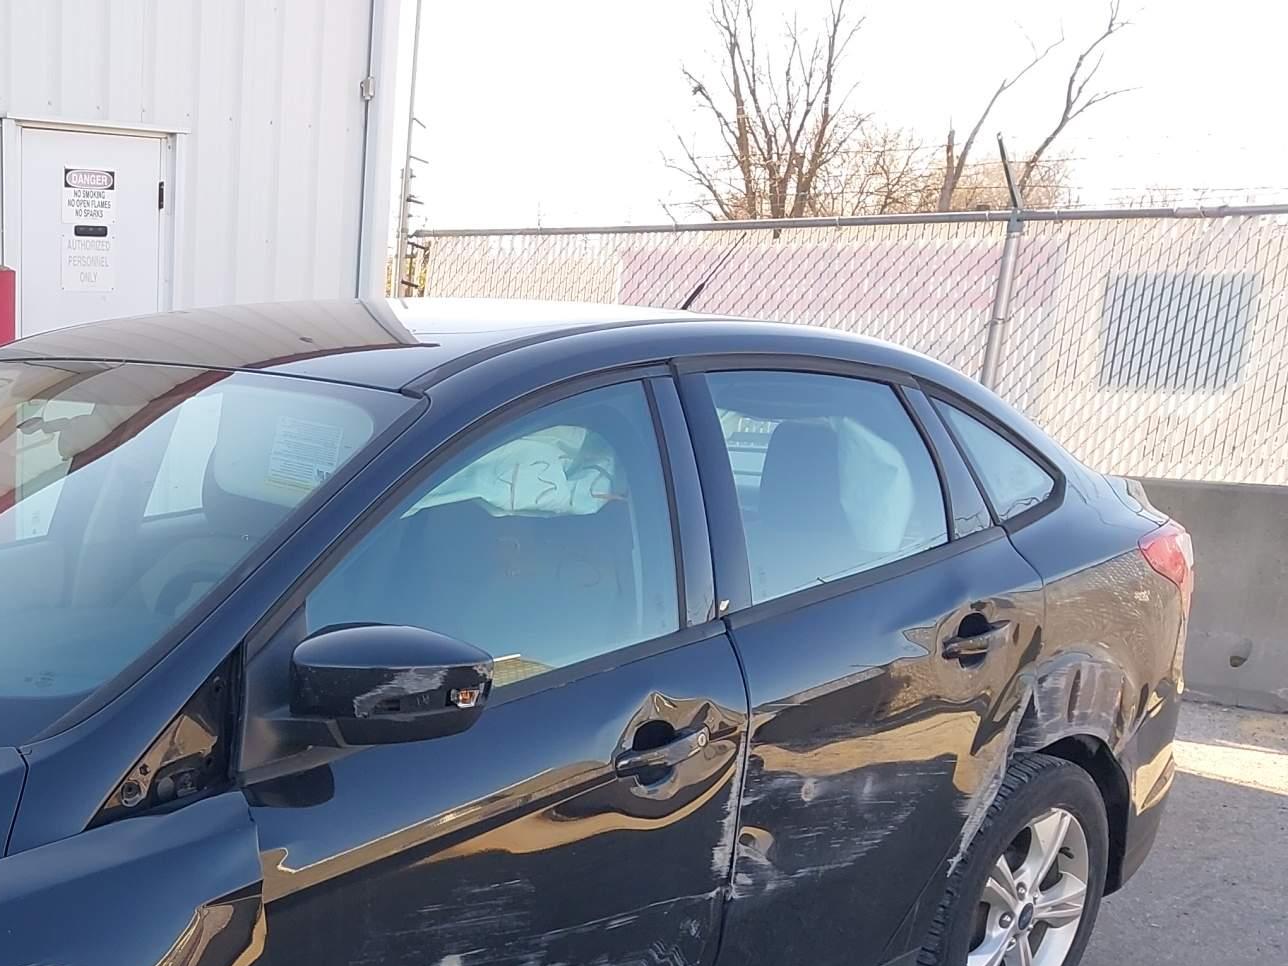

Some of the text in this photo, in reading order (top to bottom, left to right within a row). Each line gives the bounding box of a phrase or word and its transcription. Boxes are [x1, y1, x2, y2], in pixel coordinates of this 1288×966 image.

[71, 173, 108, 186] DANGER
[74, 190, 106, 199] NO SMOKING
[68, 199, 111, 209] NO OPEN FLAMES
[75, 209, 104, 218] NO SPARKS
[67, 239, 110, 251] AUTHORIZED
[68, 255, 109, 268] PERSONNEL
[79, 271, 98, 283] ONLY
